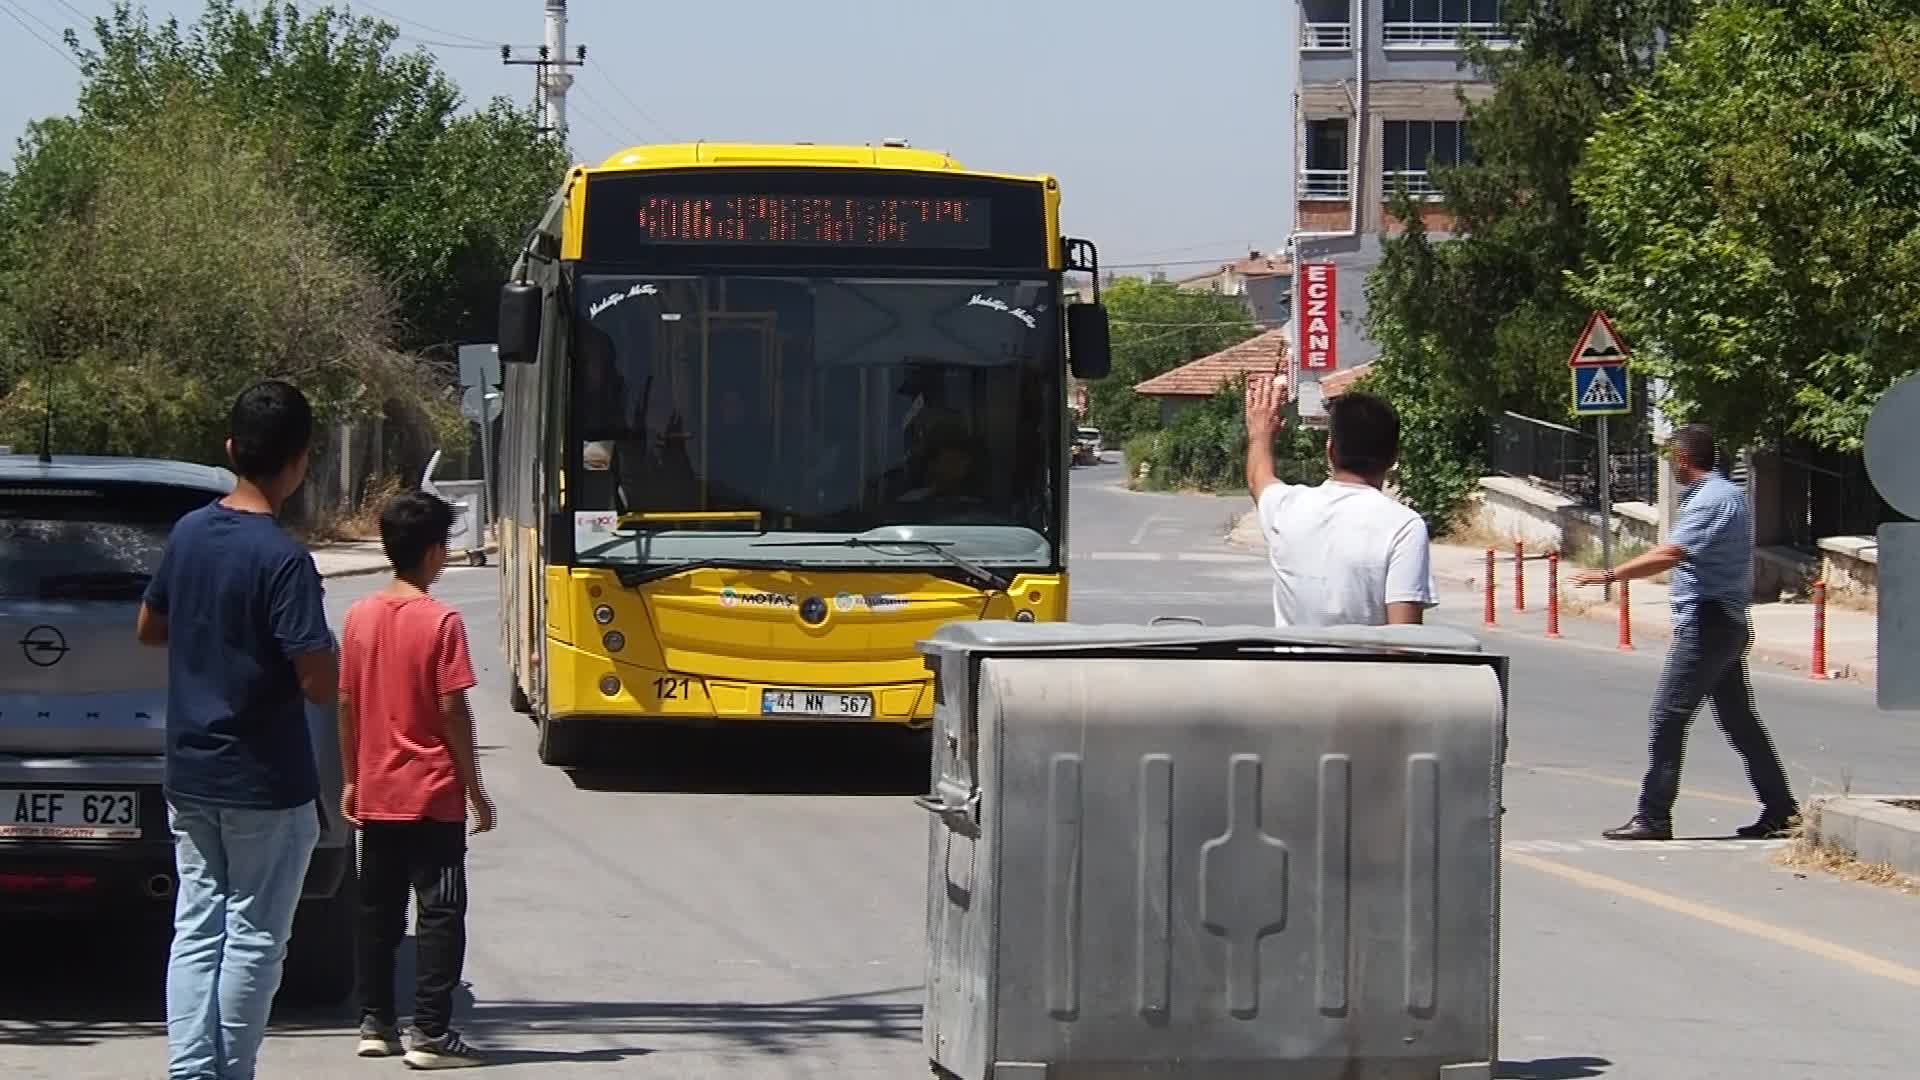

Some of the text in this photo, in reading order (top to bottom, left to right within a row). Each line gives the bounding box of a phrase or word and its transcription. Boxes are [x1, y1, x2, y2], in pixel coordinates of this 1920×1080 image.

[1307, 265, 1329, 367] ECZANE
[653, 678, 688, 700] 121
[777, 693, 868, 713] 44 NN 567
[15, 793, 133, 824] AEF 623
